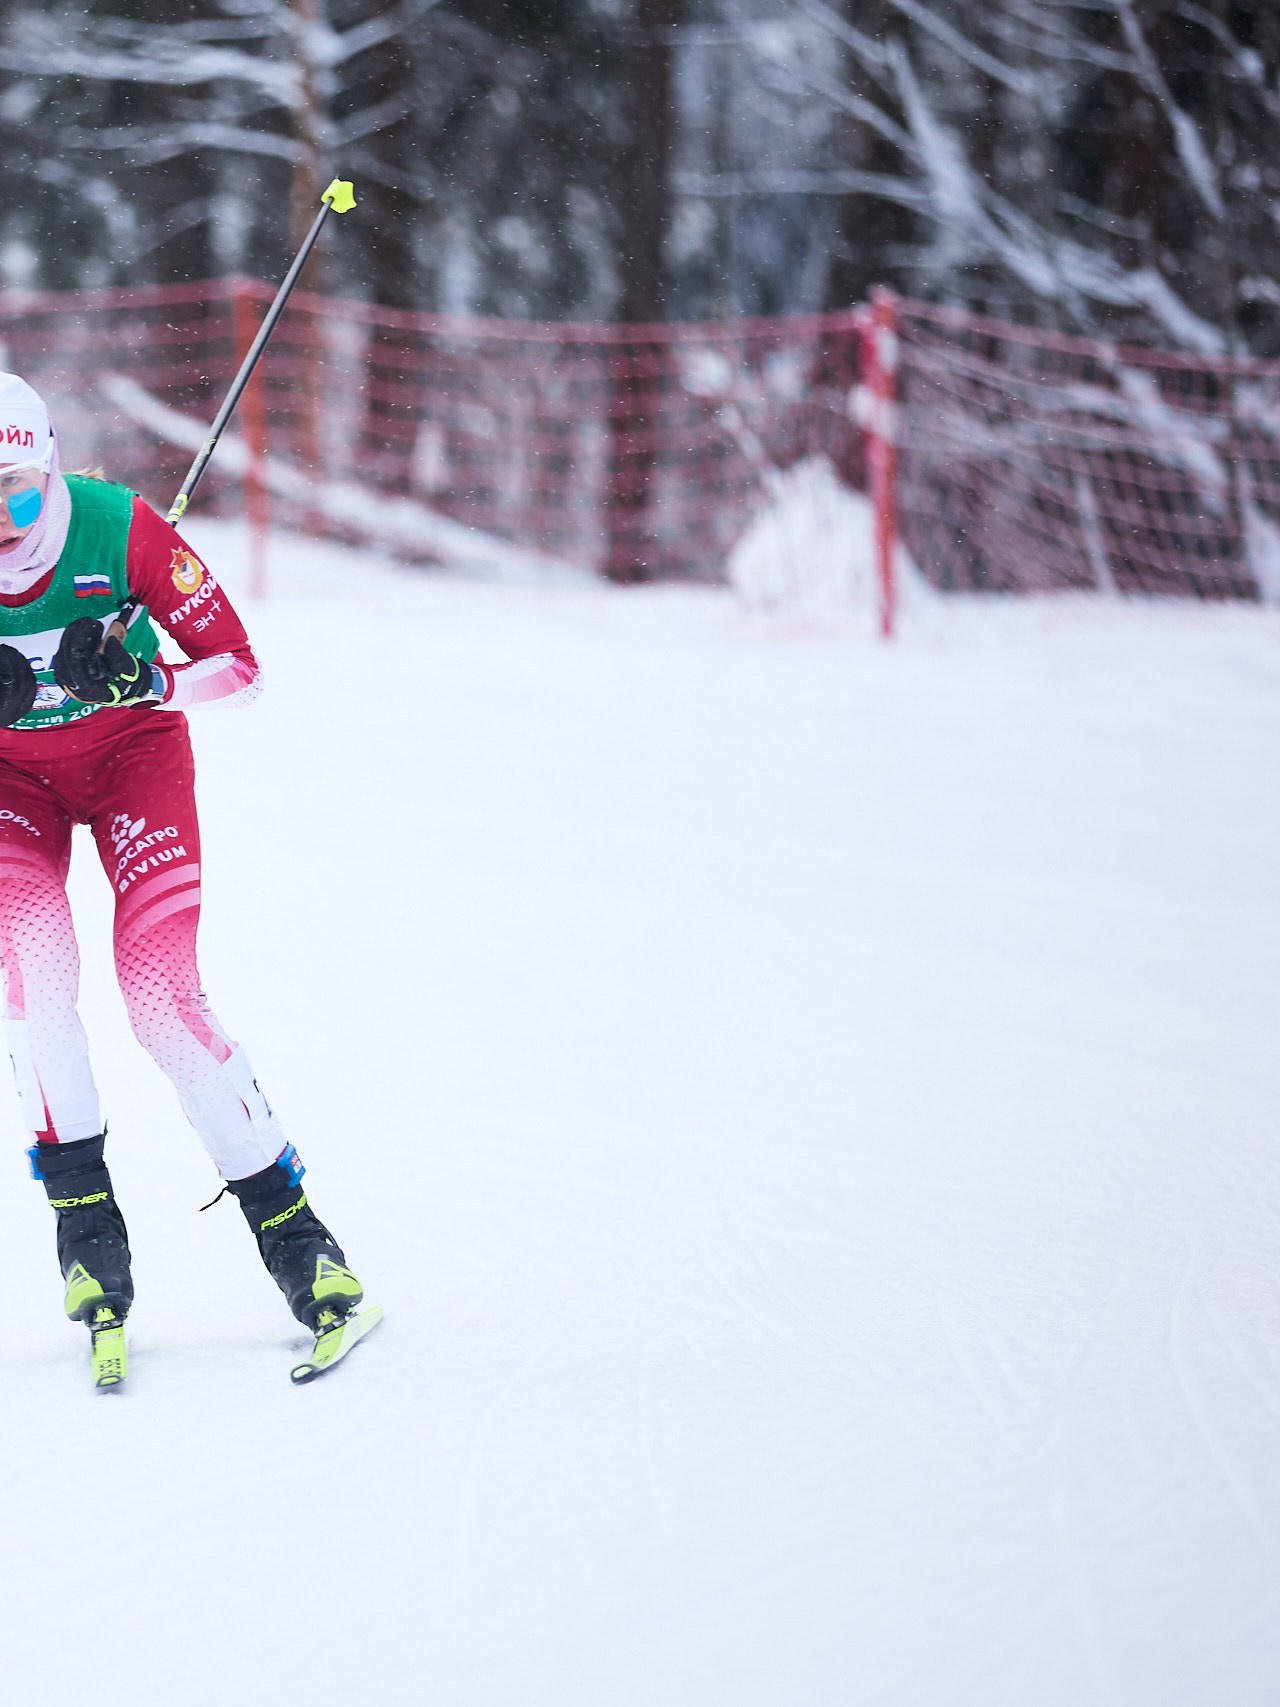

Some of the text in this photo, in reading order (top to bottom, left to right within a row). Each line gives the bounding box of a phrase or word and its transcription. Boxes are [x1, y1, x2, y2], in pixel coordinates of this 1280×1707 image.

[169, 574, 218, 625] ЛУКОЙ
[115, 826, 179, 883] ОСАГРО
[118, 845, 188, 894] BIVIUM
[260, 1193, 308, 1231] FISCHE
